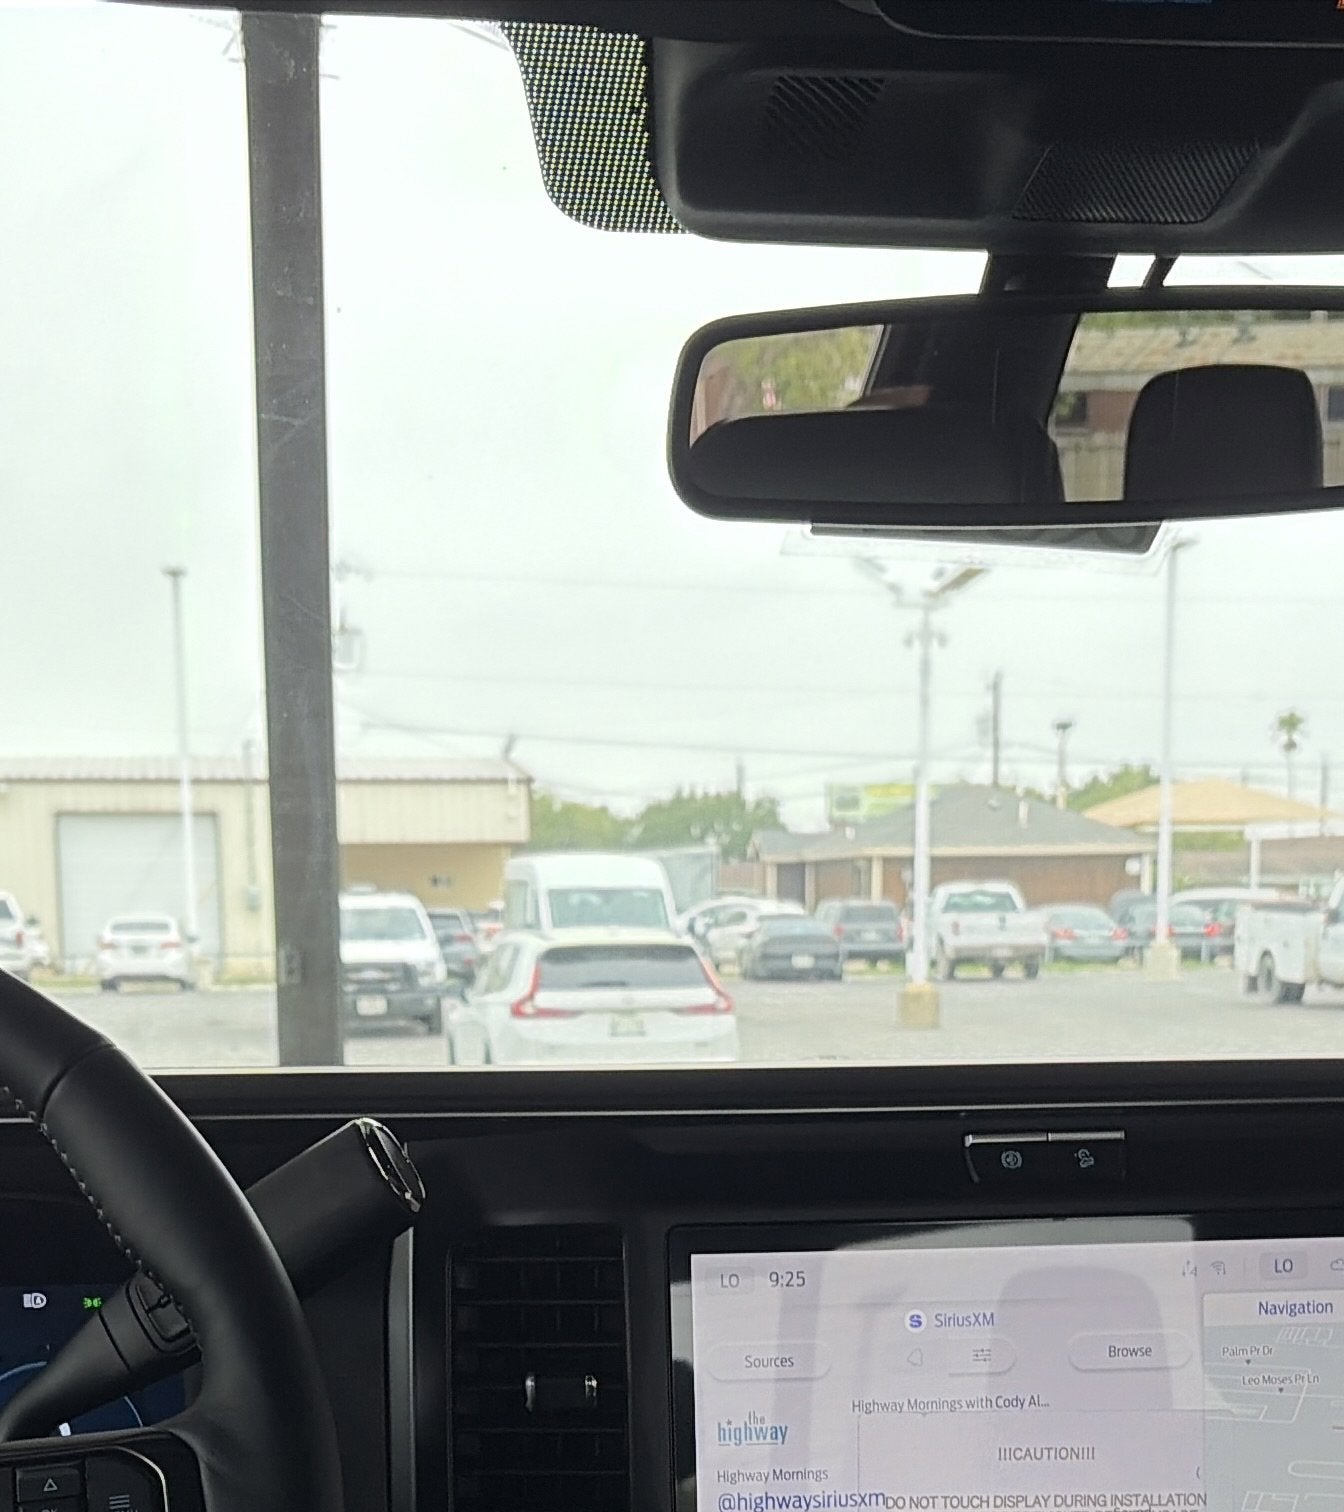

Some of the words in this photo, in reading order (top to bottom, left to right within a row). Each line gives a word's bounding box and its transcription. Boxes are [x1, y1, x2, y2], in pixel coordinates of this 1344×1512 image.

[1274, 1259, 1293, 1274] LO
[720, 1274, 739, 1288] LO
[769, 1271, 806, 1288] 9:25
[1258, 1301, 1334, 1317] Navigation
[935, 1312, 994, 1328] SiriusXM
[1108, 1345, 1152, 1358] Browse
[1222, 1346, 1248, 1357] Palm
[745, 1355, 794, 1368] Sources
[1242, 1375, 1260, 1386] Leo
[1261, 1374, 1293, 1385] Moses
[1307, 1373, 1320, 1384] Ln
[852, 1400, 904, 1414] Highway
[907, 1399, 963, 1412] Mornings
[966, 1398, 992, 1410] with
[995, 1397, 1025, 1411] Cody
[748, 1411, 766, 1425] the
[718, 1421, 788, 1446] highway
[717, 1470, 769, 1484] Highway
[772, 1468, 828, 1481] Mornings
[886, 1496, 906, 1510] DO
[909, 1496, 938, 1509] NOT
[941, 1496, 990, 1509] TOUCH
[993, 1495, 1051, 1508] DISPLAY
[1054, 1494, 1106, 1508] DURING
[1110, 1493, 1207, 1507] INSTALLATION
